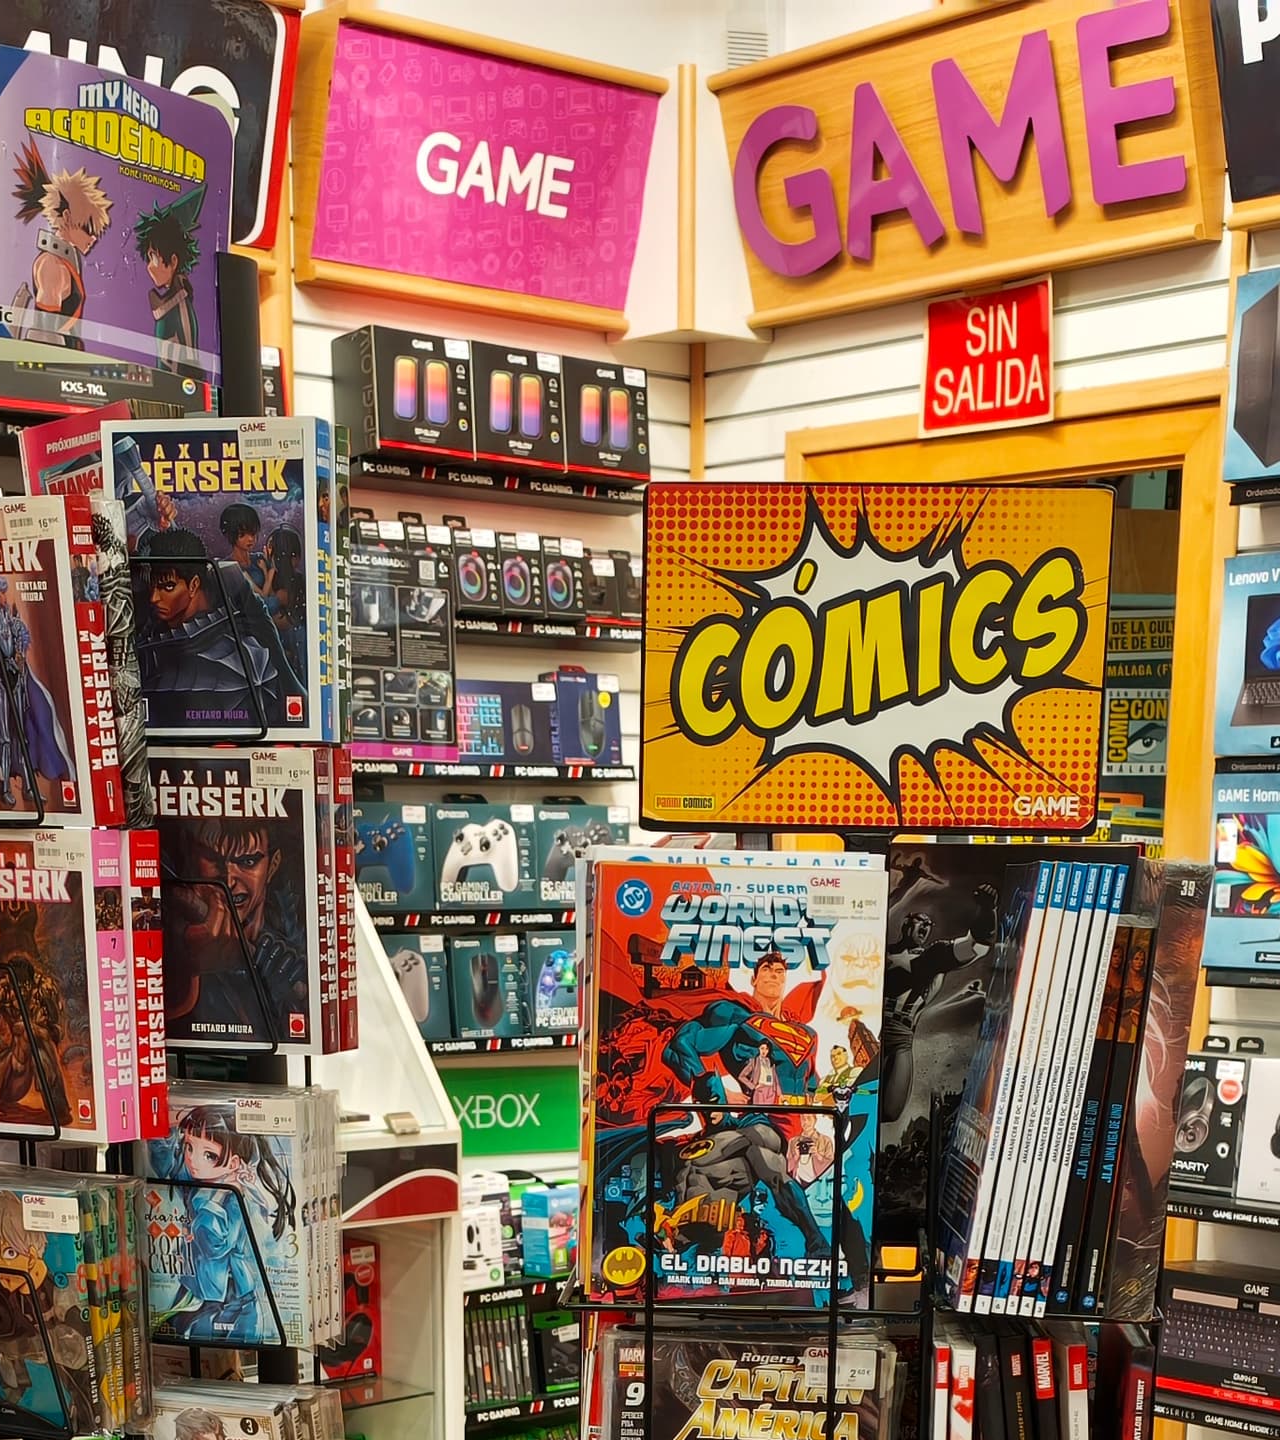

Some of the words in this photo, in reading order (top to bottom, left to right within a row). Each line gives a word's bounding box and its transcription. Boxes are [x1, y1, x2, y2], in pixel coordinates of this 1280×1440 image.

[78, 81, 120, 111] MY
[122, 86, 160, 129] HERO
[25, 108, 207, 183] ACADEMIA
[732, 0, 1189, 279] GAME
[415, 131, 575, 220] GAME
[964, 302, 1019, 353] SIN
[931, 354, 1047, 416] SALIDA
[1229, 569, 1268, 585] Lenovo
[671, 538, 1086, 739] CÓMICS
[1014, 797, 1080, 817] GAME
[1218, 790, 1248, 804] GAME
[1251, 789, 1279, 803] Home
[660, 924, 836, 970] FINEST
[103, 957, 118, 1090] MAXIMUM
[191, 1022, 225, 1034] KENTARO
[228, 1022, 253, 1034] MIURA
[455, 1094, 541, 1128] XBOX
[660, 1255, 688, 1273] EL
[694, 1256, 769, 1274] DIABLO
[741, 1351, 793, 1365] Rogers
[1038, 1350, 1051, 1390] MARVEL
[626, 1384, 645, 1407] 9
